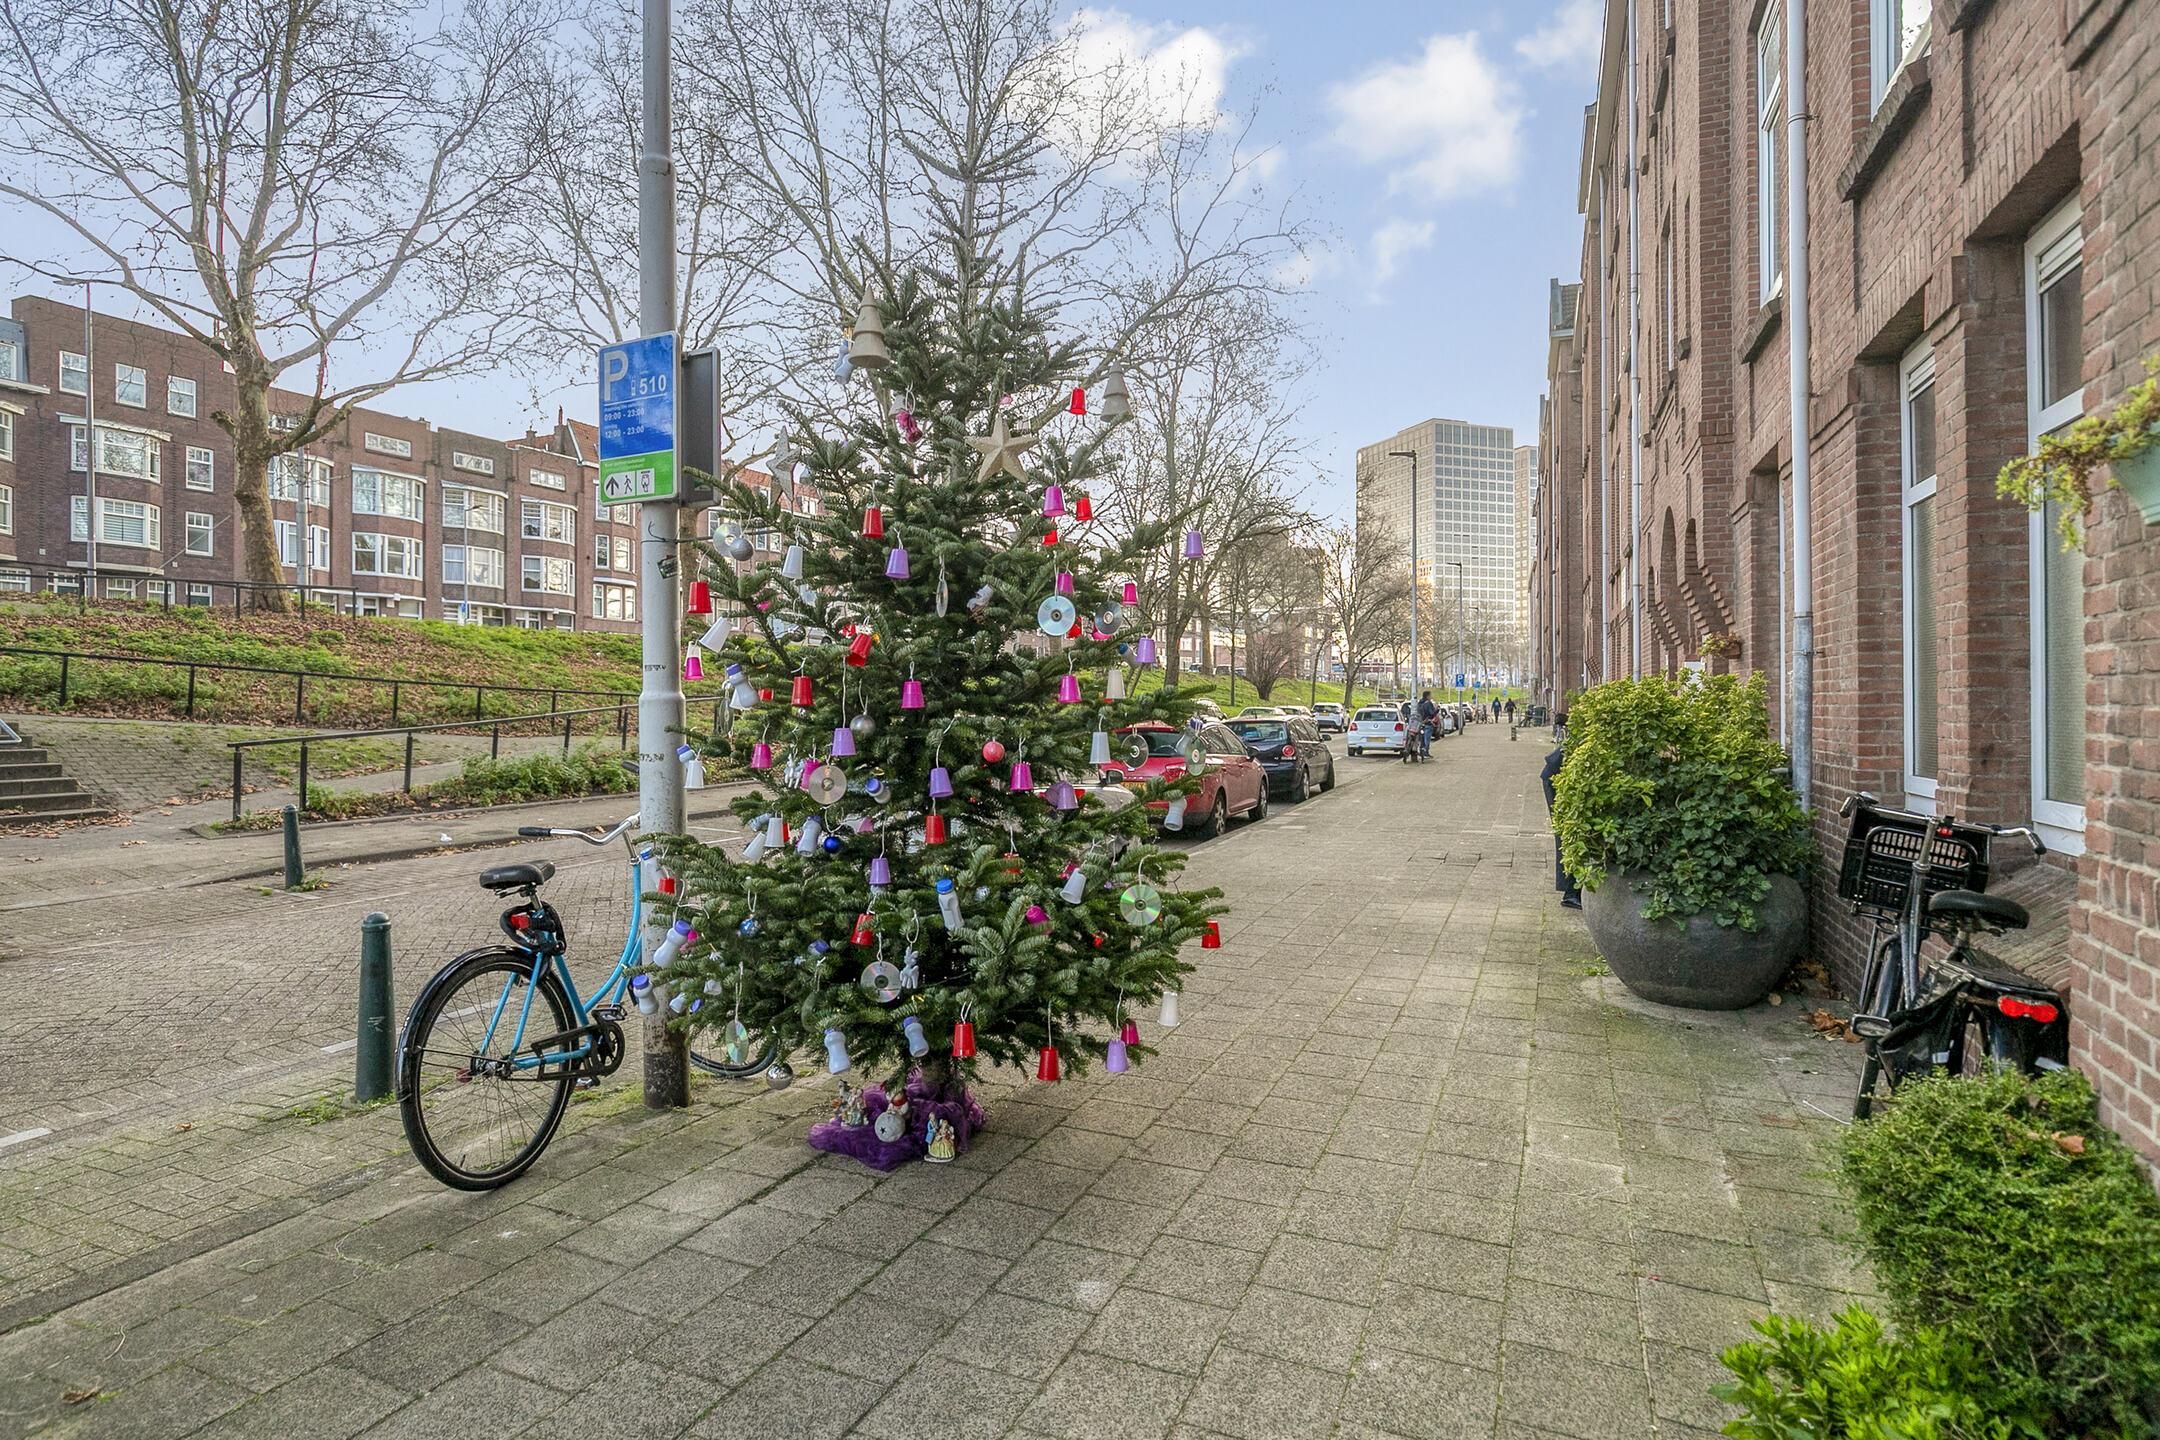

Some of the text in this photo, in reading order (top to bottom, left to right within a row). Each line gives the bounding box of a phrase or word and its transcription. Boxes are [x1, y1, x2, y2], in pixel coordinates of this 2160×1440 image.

[604, 350, 629, 401] P
[640, 375, 667, 395] 510
[627, 408, 645, 418] 23:00
[627, 426, 645, 436] 23:00
